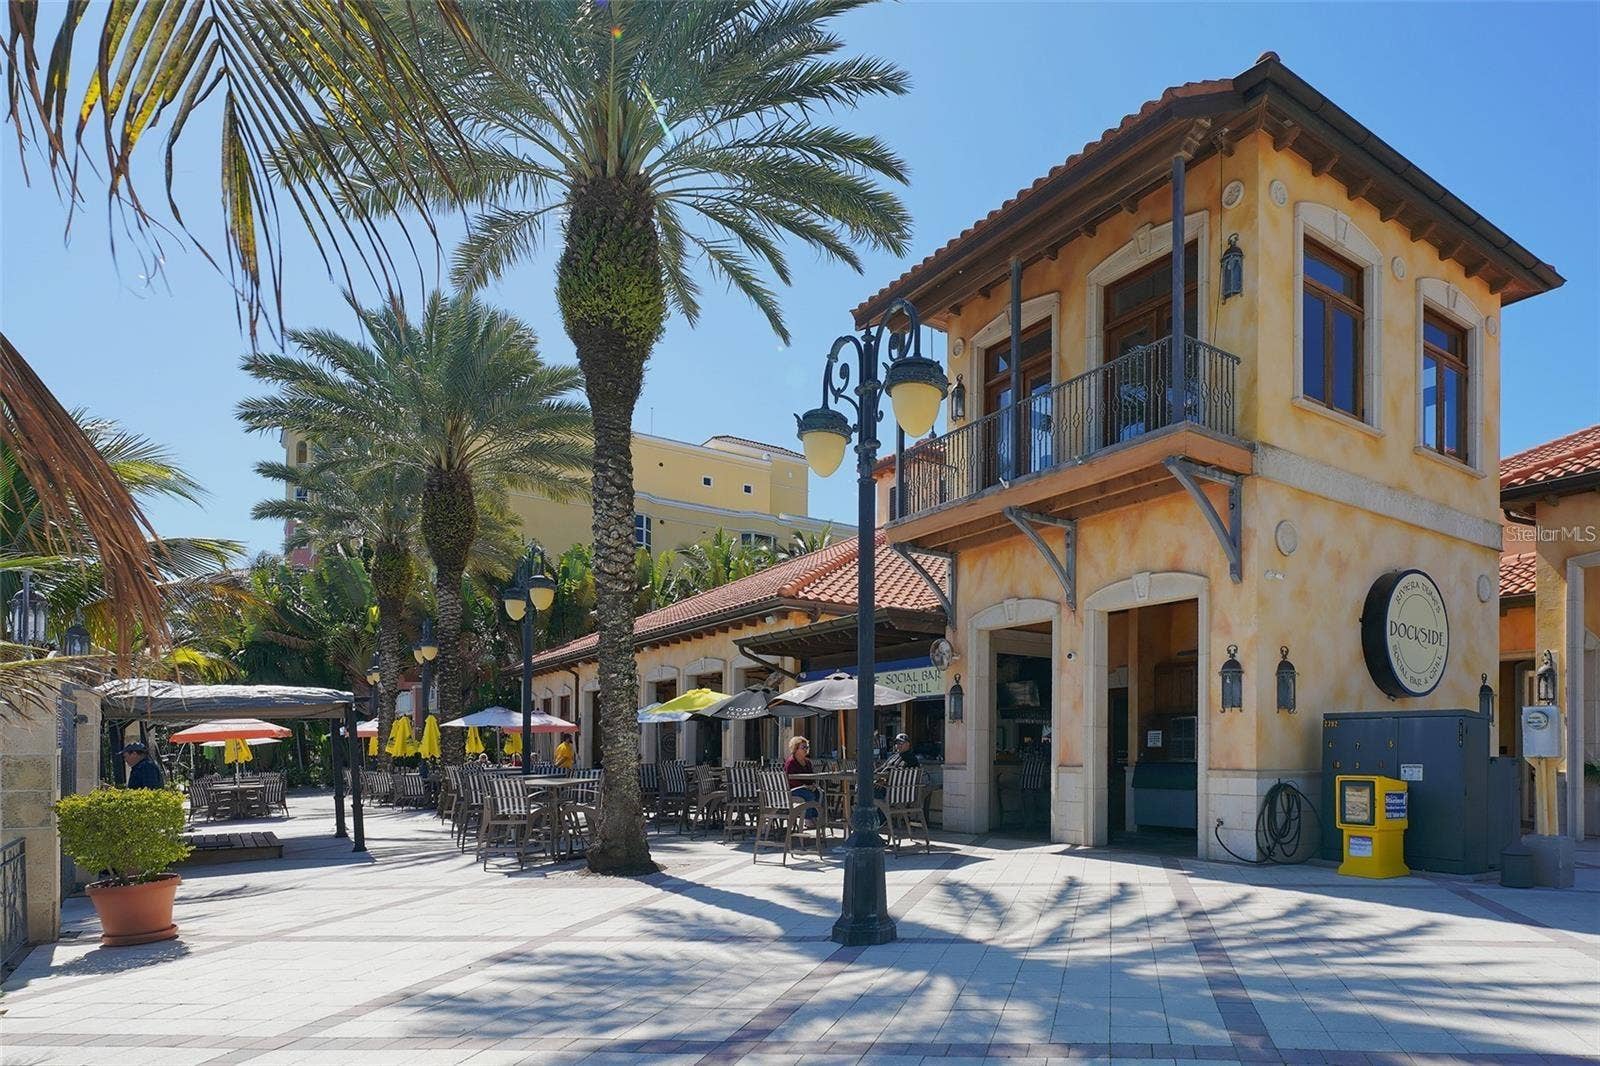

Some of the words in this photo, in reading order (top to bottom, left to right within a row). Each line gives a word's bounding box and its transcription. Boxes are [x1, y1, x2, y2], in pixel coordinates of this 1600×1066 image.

[1390, 620, 1445, 649] DOCKSIDE
[885, 671, 919, 685] SOCIAL
[921, 669, 942, 682] BAR
[1429, 655, 1443, 680] GRILL
[903, 682, 931, 696] GRILL
